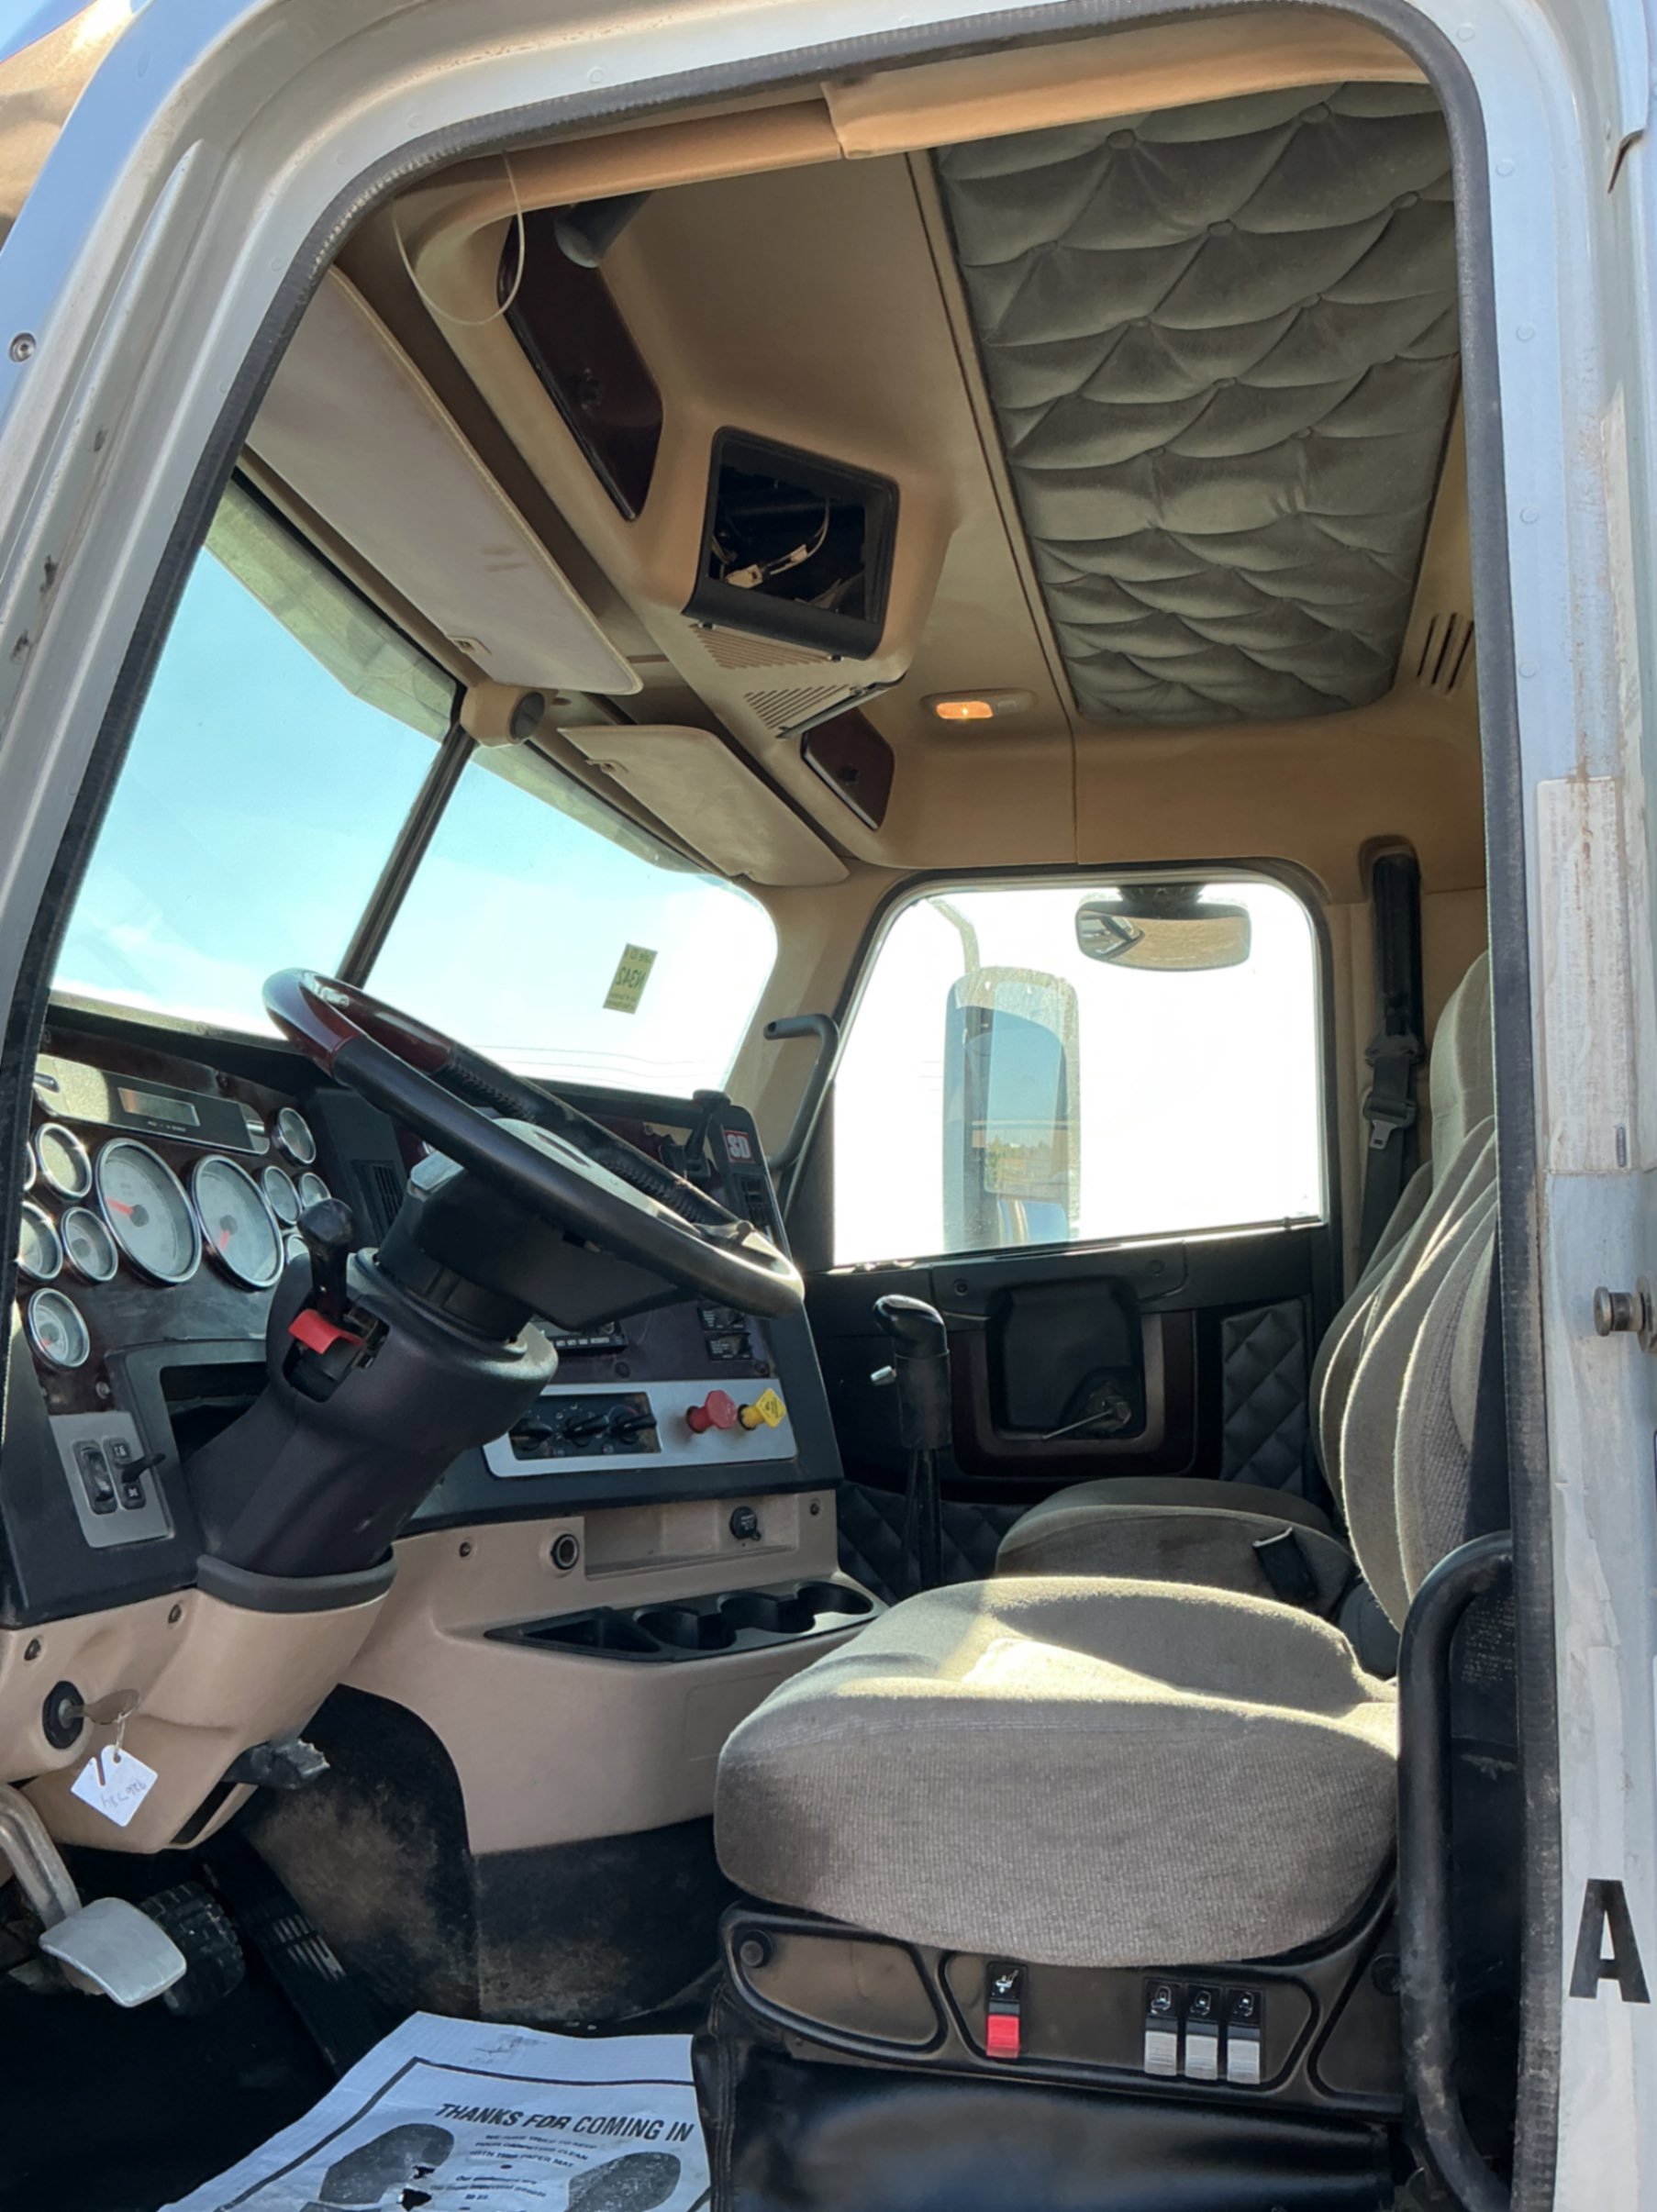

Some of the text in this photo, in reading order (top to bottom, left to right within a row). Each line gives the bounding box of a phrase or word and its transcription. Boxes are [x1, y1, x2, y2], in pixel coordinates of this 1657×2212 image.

[727, 1133, 751, 1159] SD
[1568, 1878, 1651, 2004] A
[435, 2103, 695, 2142] THANKS FOR COMING IN
